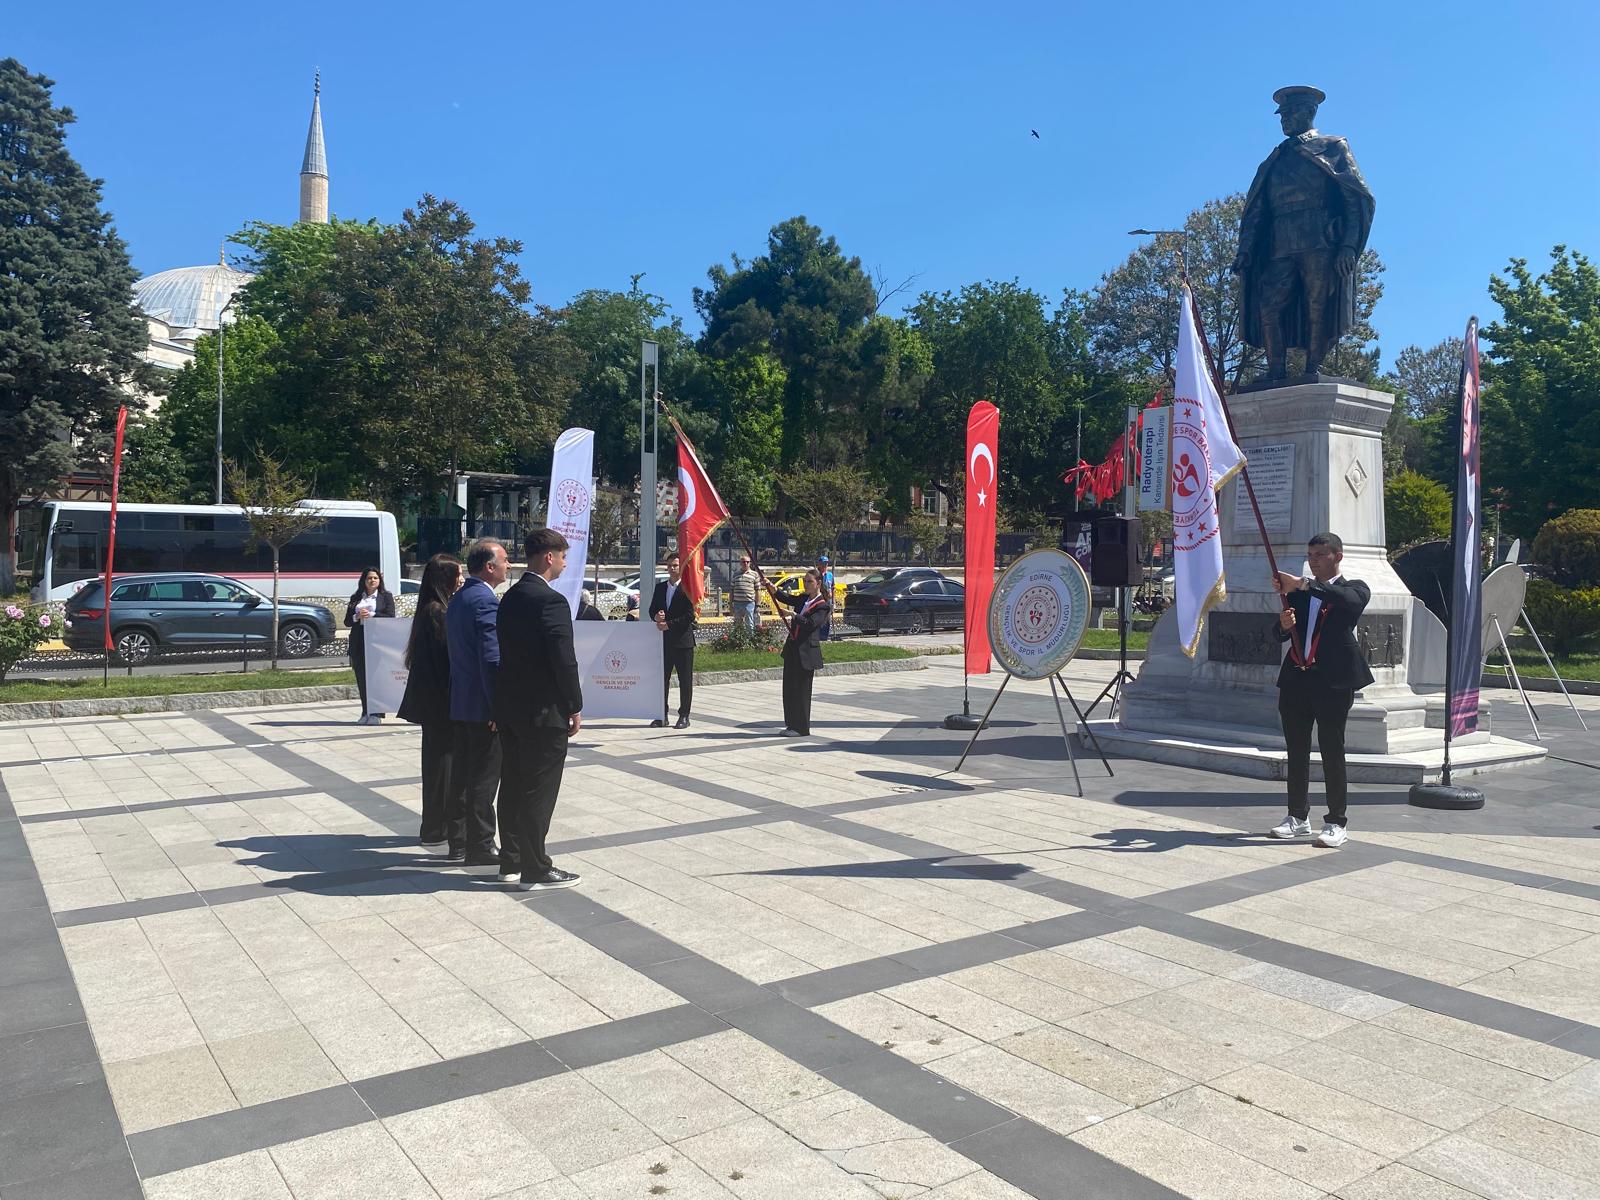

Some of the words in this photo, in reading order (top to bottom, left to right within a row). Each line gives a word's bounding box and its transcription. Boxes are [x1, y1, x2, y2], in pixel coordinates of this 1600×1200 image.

[1180, 426, 1198, 439] SPOR
[1142, 427, 1155, 493] Radyoterapi
[1154, 466, 1163, 503] Kanserde
[1010, 639, 1018, 649] VE
[1018, 647, 1036, 656] SPOR
